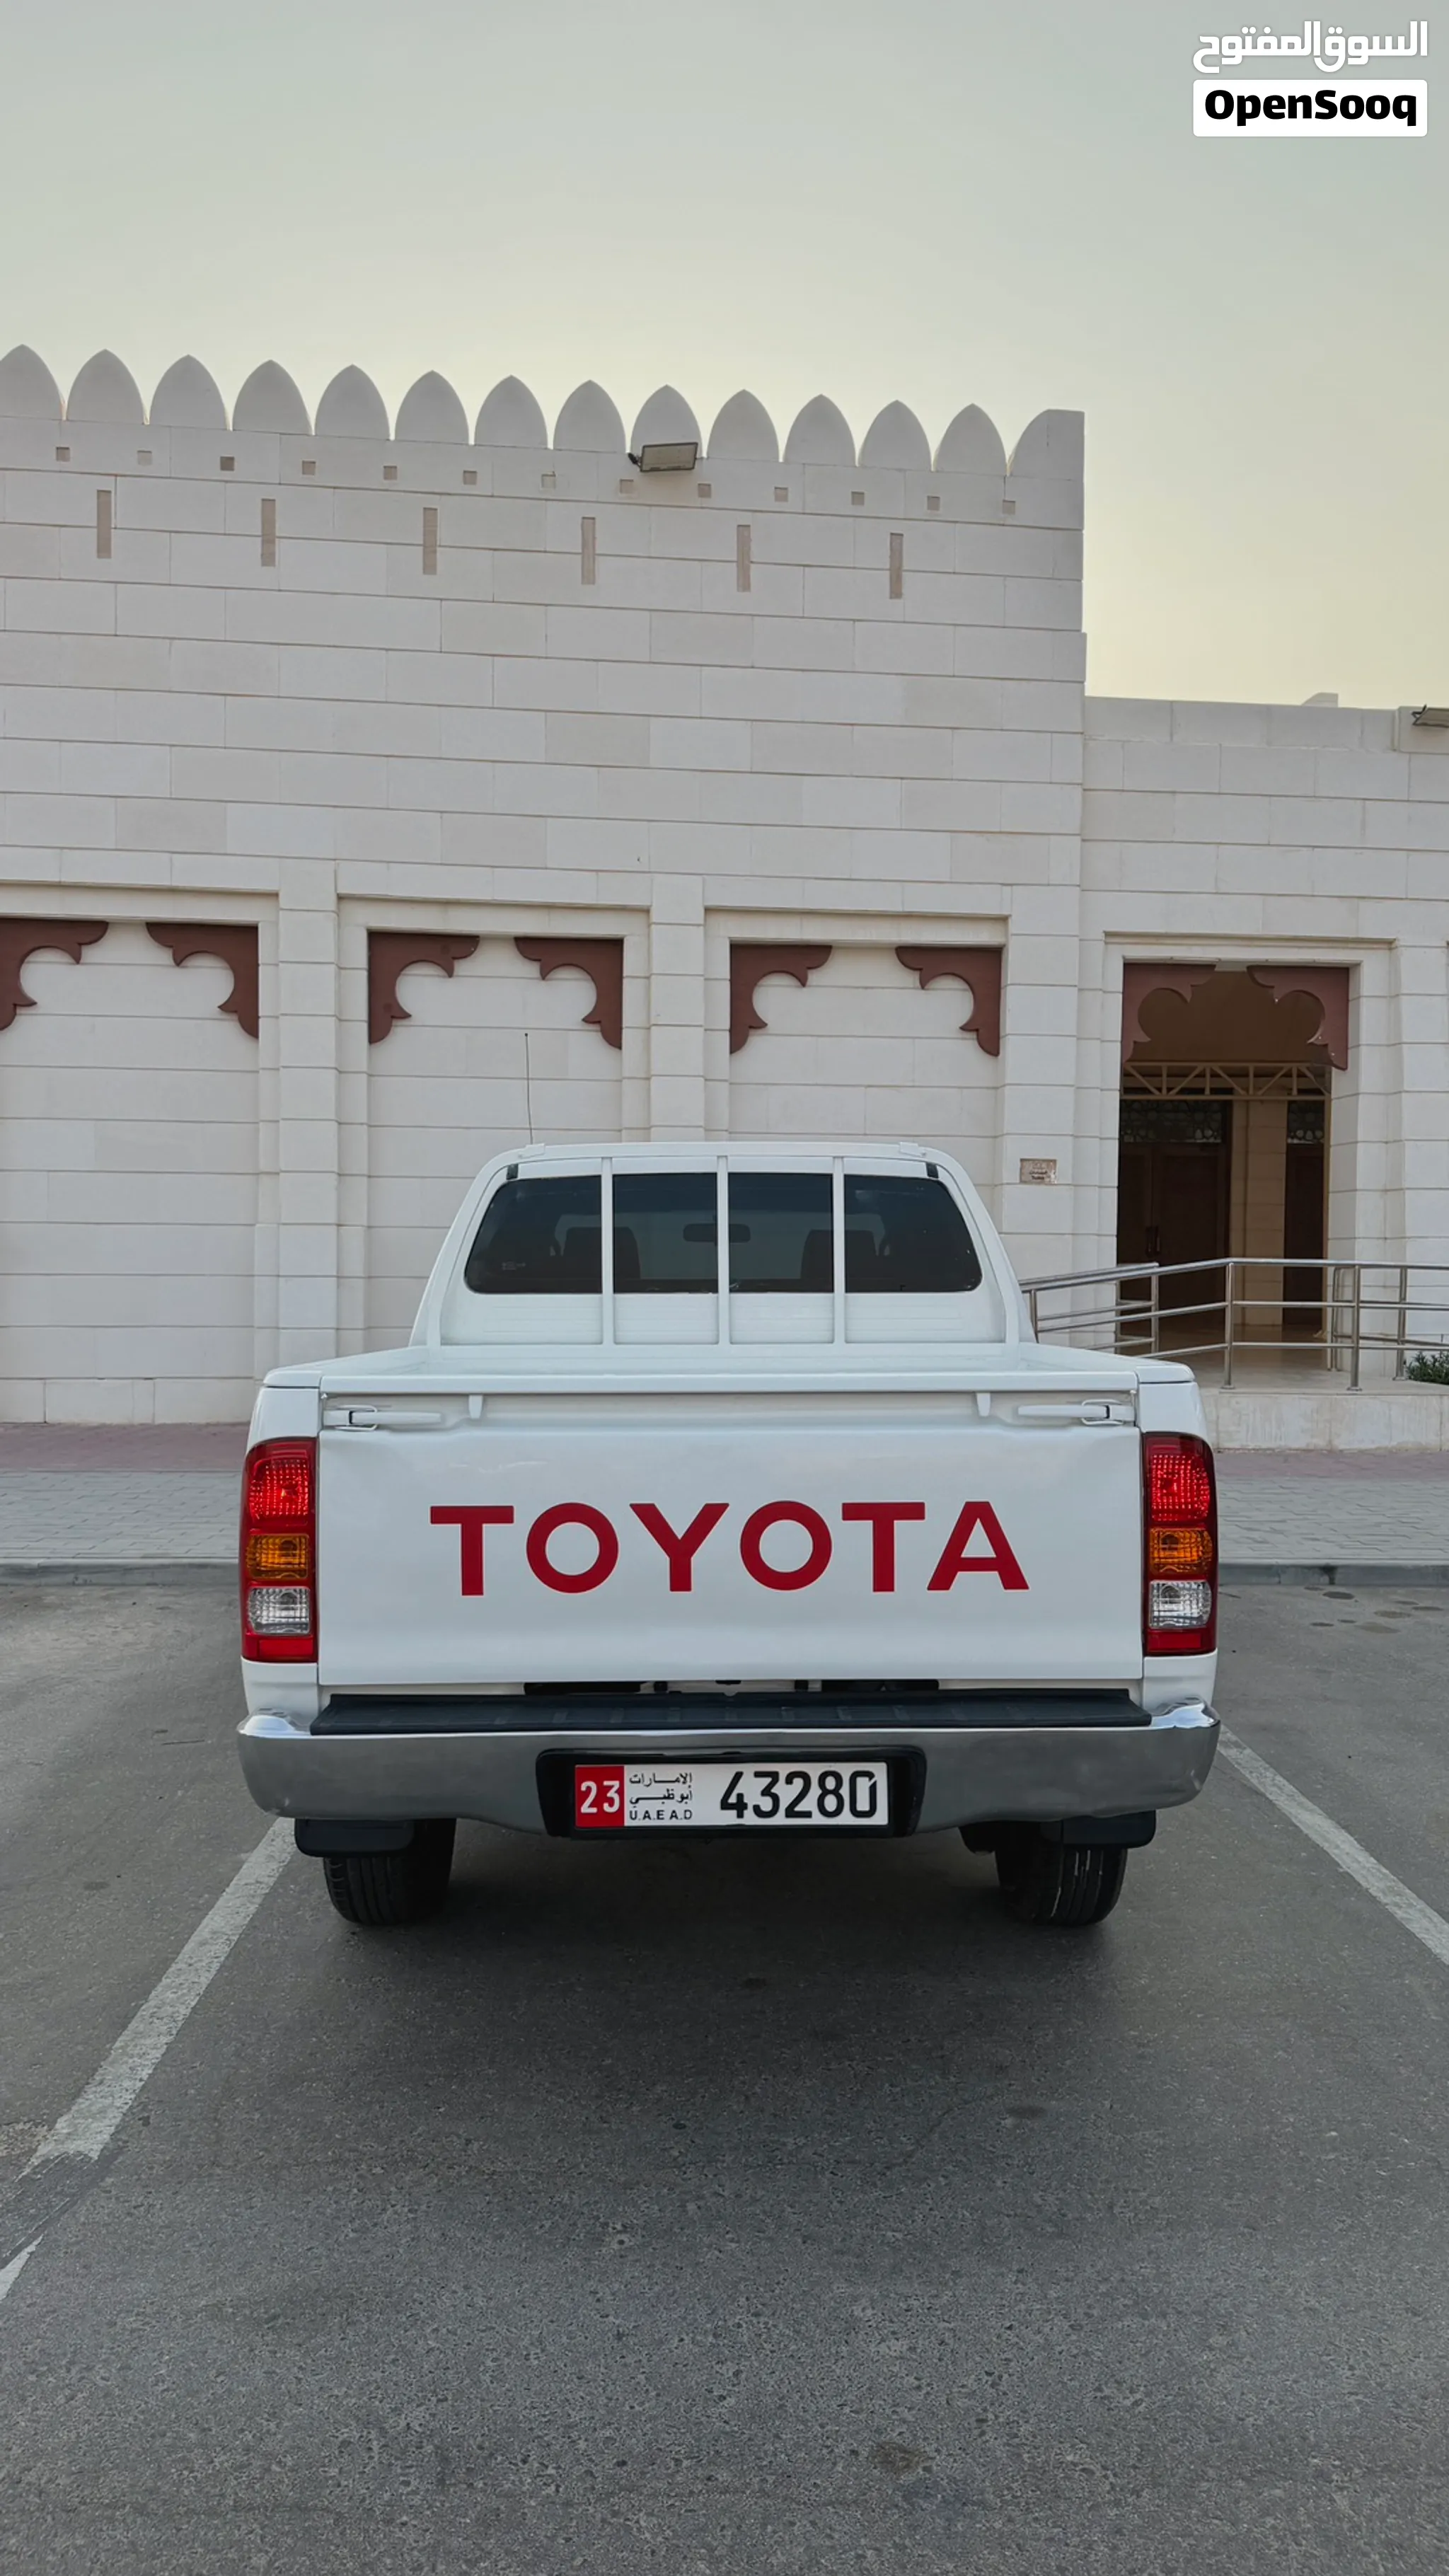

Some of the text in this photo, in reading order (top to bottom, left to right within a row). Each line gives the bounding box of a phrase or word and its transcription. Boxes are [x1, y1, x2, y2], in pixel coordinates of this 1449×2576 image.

[430, 1500, 1029, 1595] TOYOTA
[579, 1780, 620, 1813] 23
[720, 1770, 877, 1819] 43280
